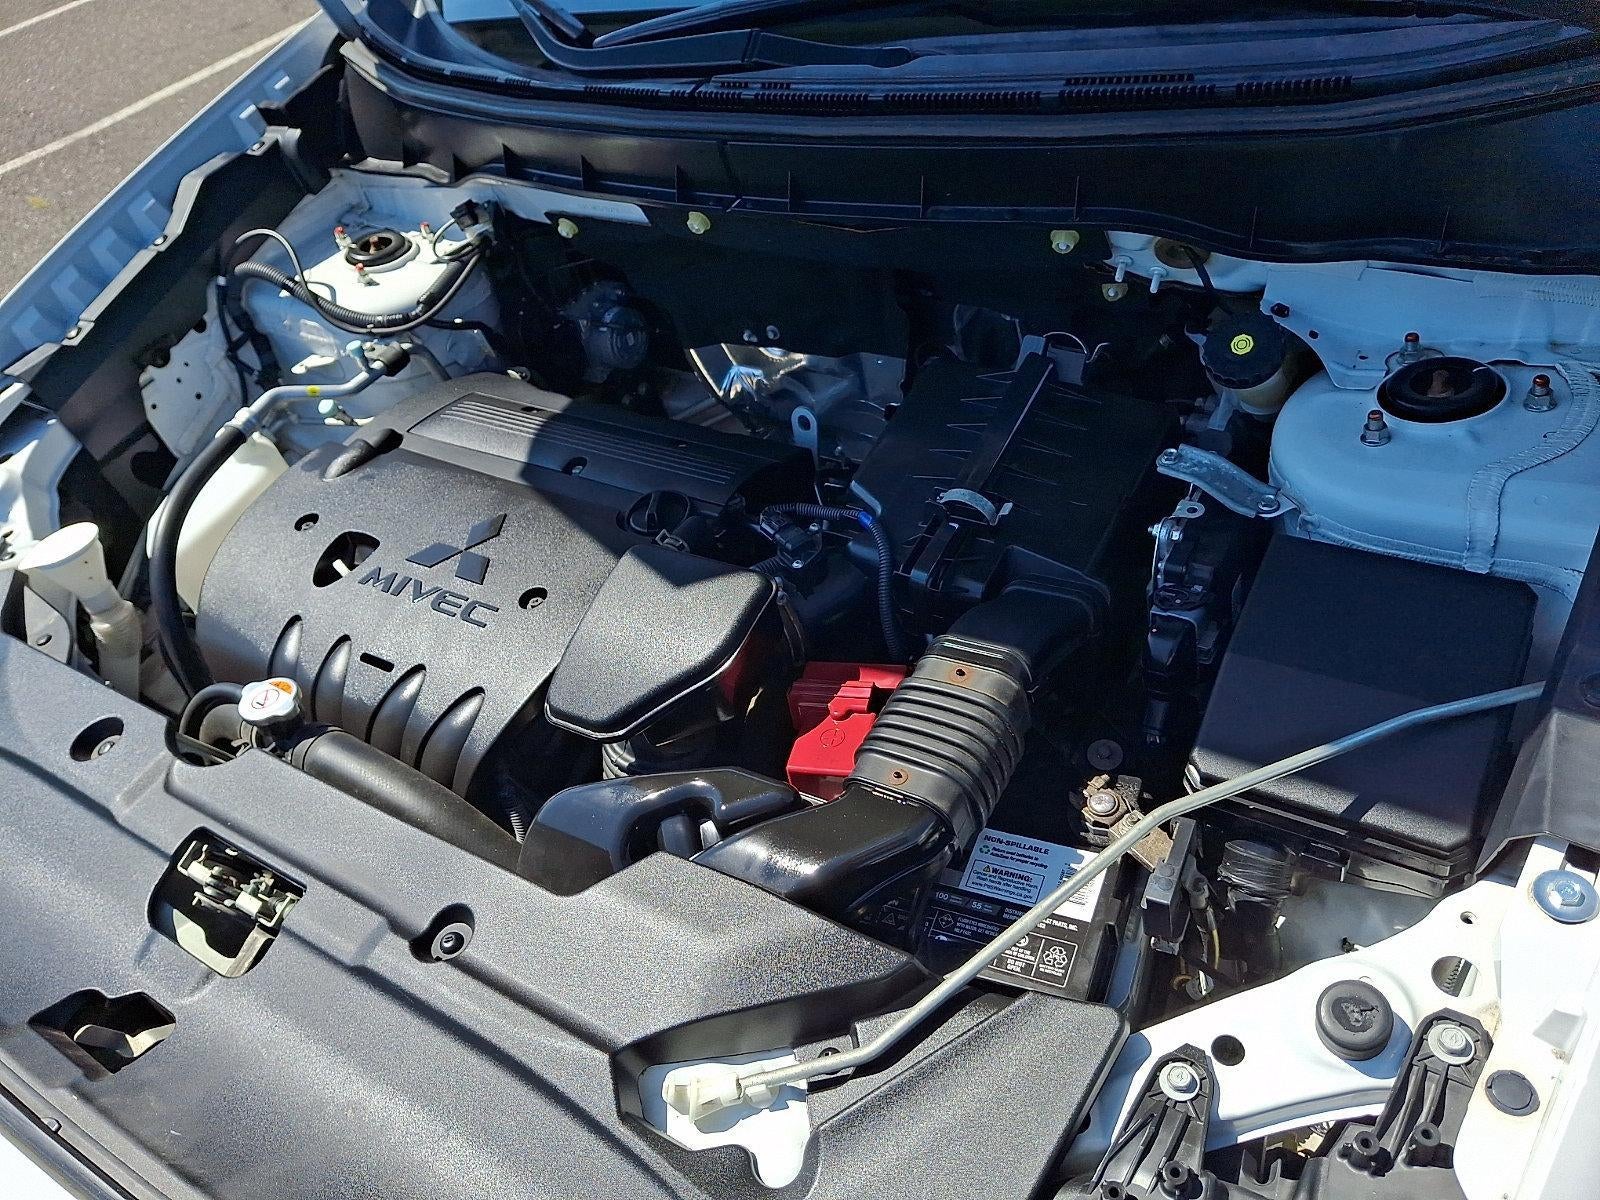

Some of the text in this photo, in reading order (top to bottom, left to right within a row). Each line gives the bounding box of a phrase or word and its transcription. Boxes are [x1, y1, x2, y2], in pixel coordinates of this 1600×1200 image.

[358, 566, 500, 628] MIVEC
[984, 834, 1049, 855] NON-SPILLABLE
[992, 867, 1033, 882] WARNING:
[935, 891, 949, 900] 100
[971, 901, 983, 909] 55
